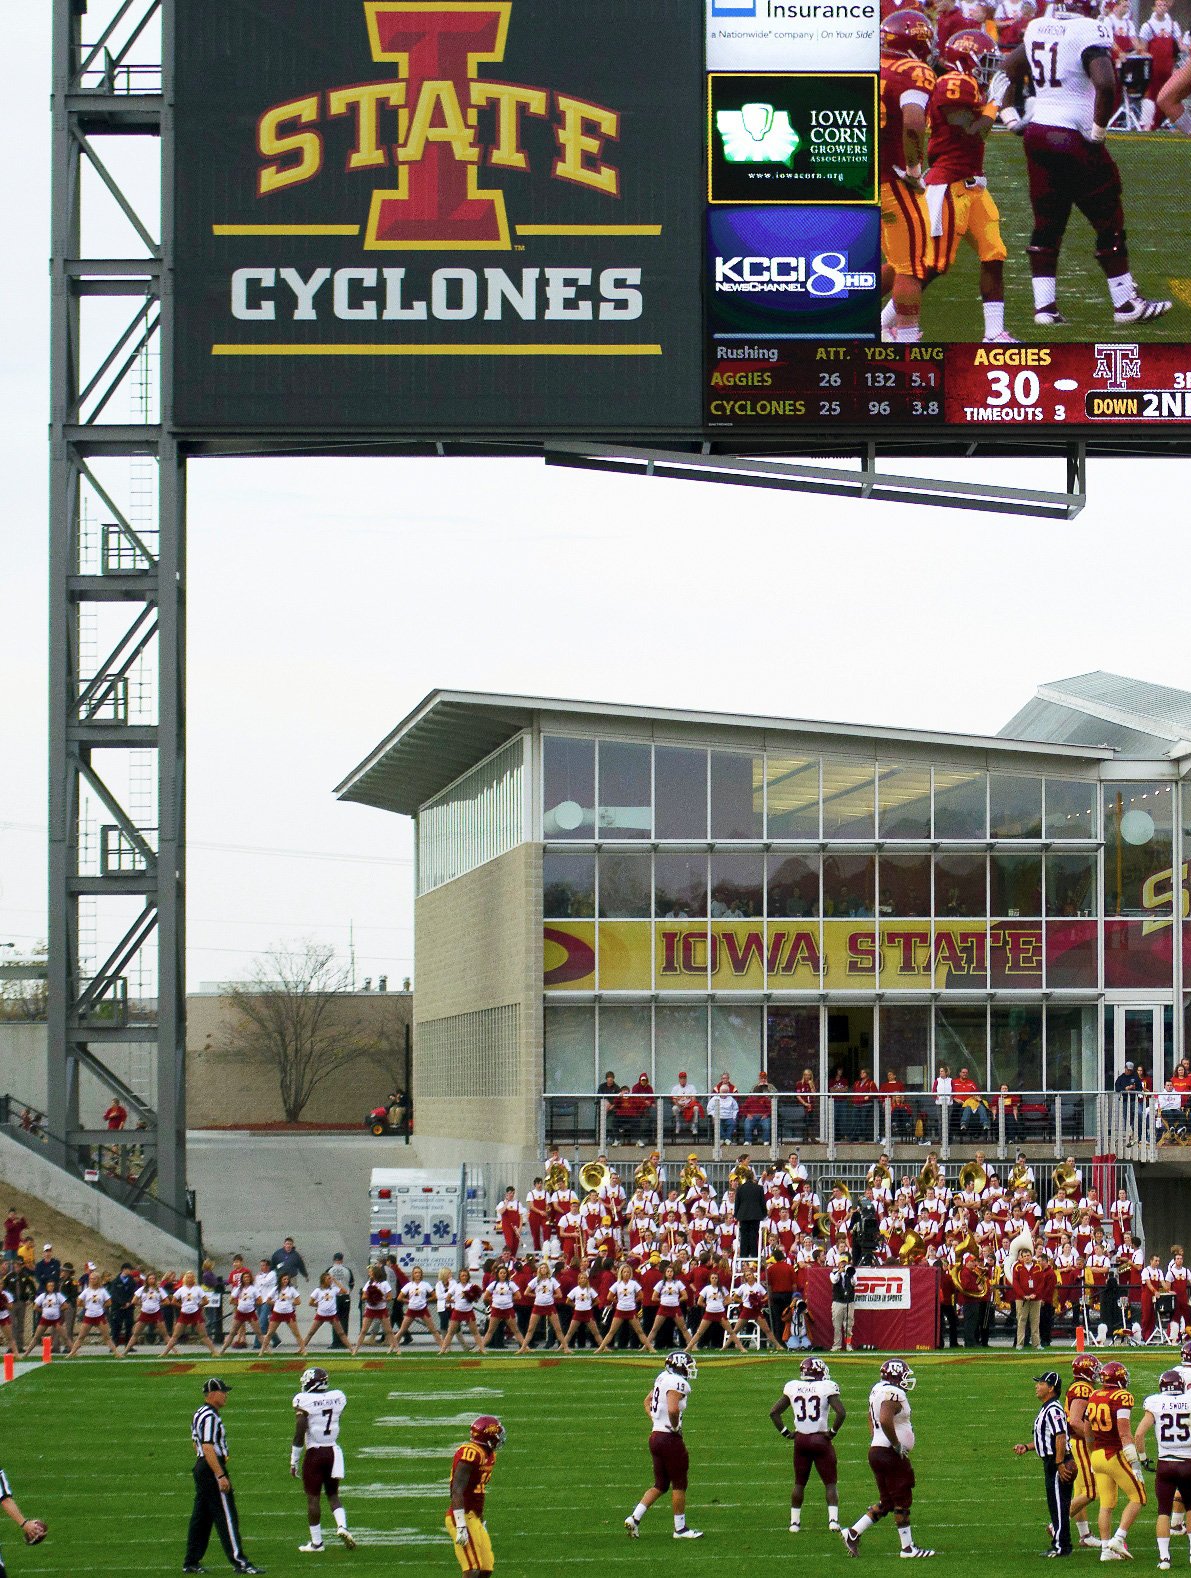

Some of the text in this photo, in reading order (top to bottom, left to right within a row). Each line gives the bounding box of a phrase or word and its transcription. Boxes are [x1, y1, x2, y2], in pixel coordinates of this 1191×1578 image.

[767, 0, 875, 18] Insurance
[774, 32, 814, 40] company
[821, 30, 833, 39] On
[1032, 41, 1062, 88] 51
[946, 79, 961, 99] 5
[810, 110, 868, 126] IOWA
[258, 81, 620, 198] STATE
[810, 127, 867, 143] CORN
[810, 145, 868, 154] GROWERS
[810, 155, 868, 163] ASSOCIATION
[748, 171, 844, 182] www.iowacorn.org
[715, 257, 806, 281] KCCI
[806, 252, 846, 295] 8
[844, 274, 873, 287] HD
[231, 268, 642, 321] CYCLONES
[717, 346, 943, 361] Rushing ATT. YDS. AVG
[974, 348, 1051, 366] AGGIES
[710, 372, 936, 387] AGGIES 26 132 5.1
[986, 370, 1040, 406] 30
[710, 400, 939, 415] CYCLONES 25 96 3.8
[964, 405, 1066, 421] TIMEOUTS 3
[1094, 399, 1138, 415] DOWN
[658, 930, 1045, 976] IOWA STATE
[854, 1276, 903, 1294] SPN
[794, 1396, 820, 1422] 33
[1121, 1395, 1134, 1406] 20
[321, 1408, 333, 1436] 7
[1088, 1403, 1113, 1431] 20
[1160, 1413, 1190, 1442] 25
[461, 1447, 477, 1462] 10
